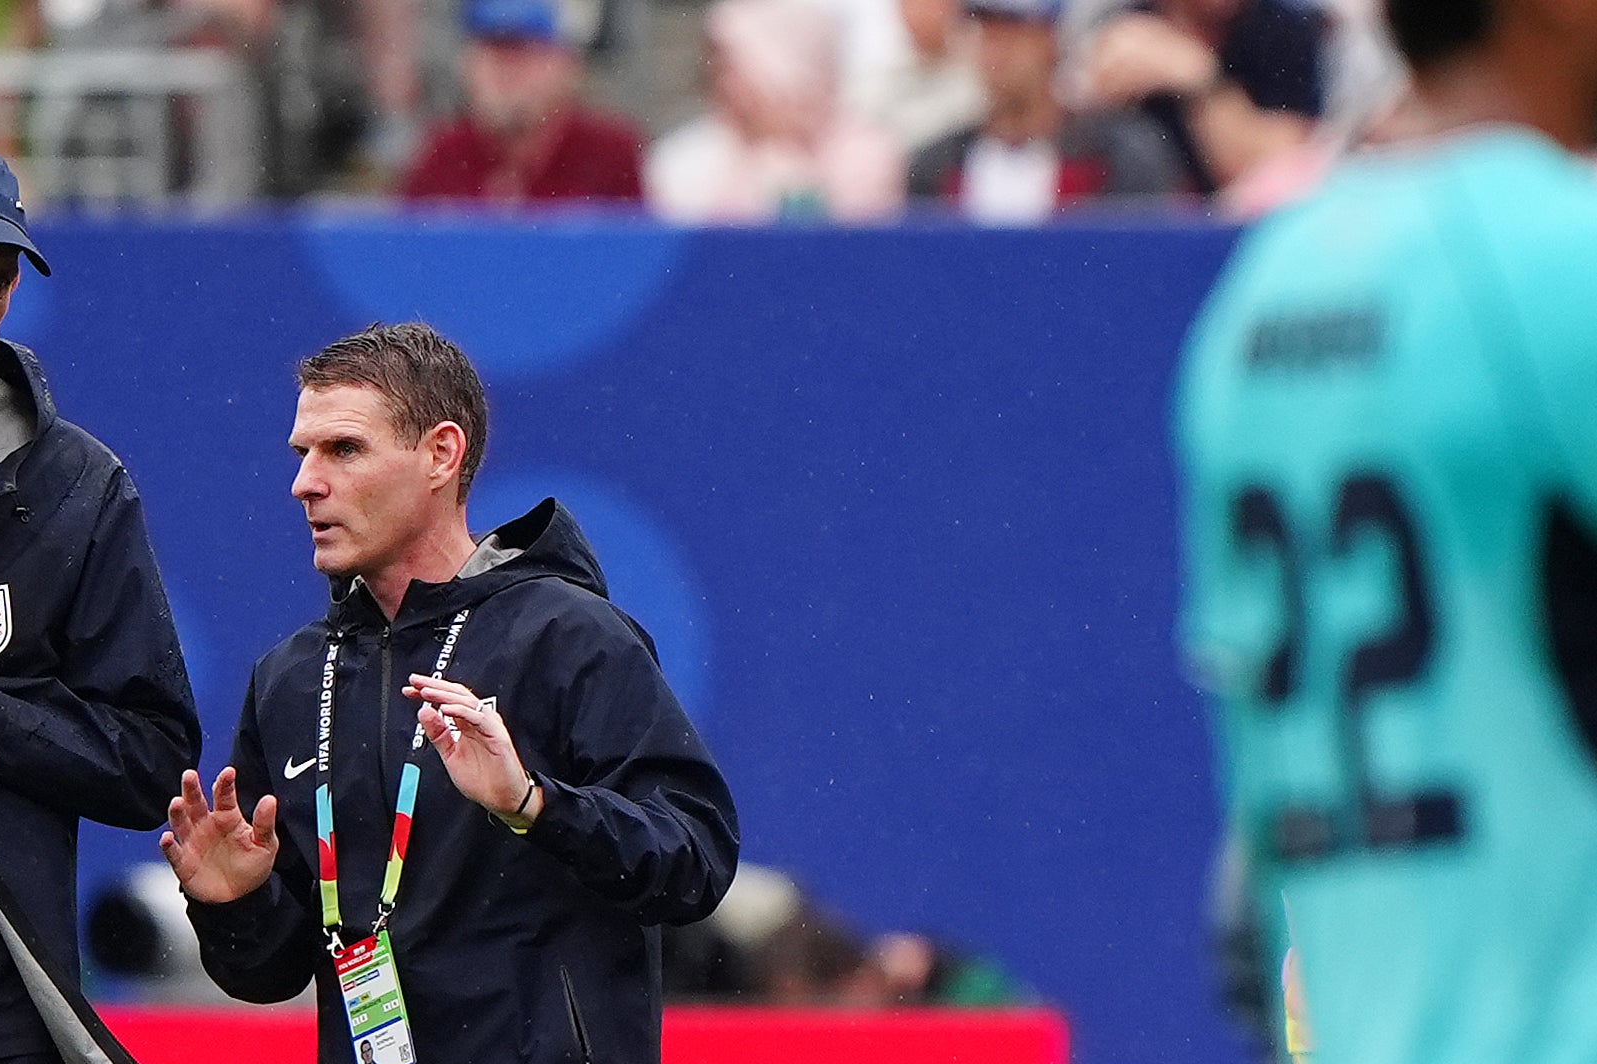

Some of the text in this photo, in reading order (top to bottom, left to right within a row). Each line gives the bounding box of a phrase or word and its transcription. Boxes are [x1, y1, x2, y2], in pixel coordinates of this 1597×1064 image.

[435, 624, 463, 672] WORLD
[1231, 472, 1471, 861] 22
[323, 662, 335, 689] CUP
[319, 690, 332, 740] WORLD
[319, 740, 329, 772] FIFA
